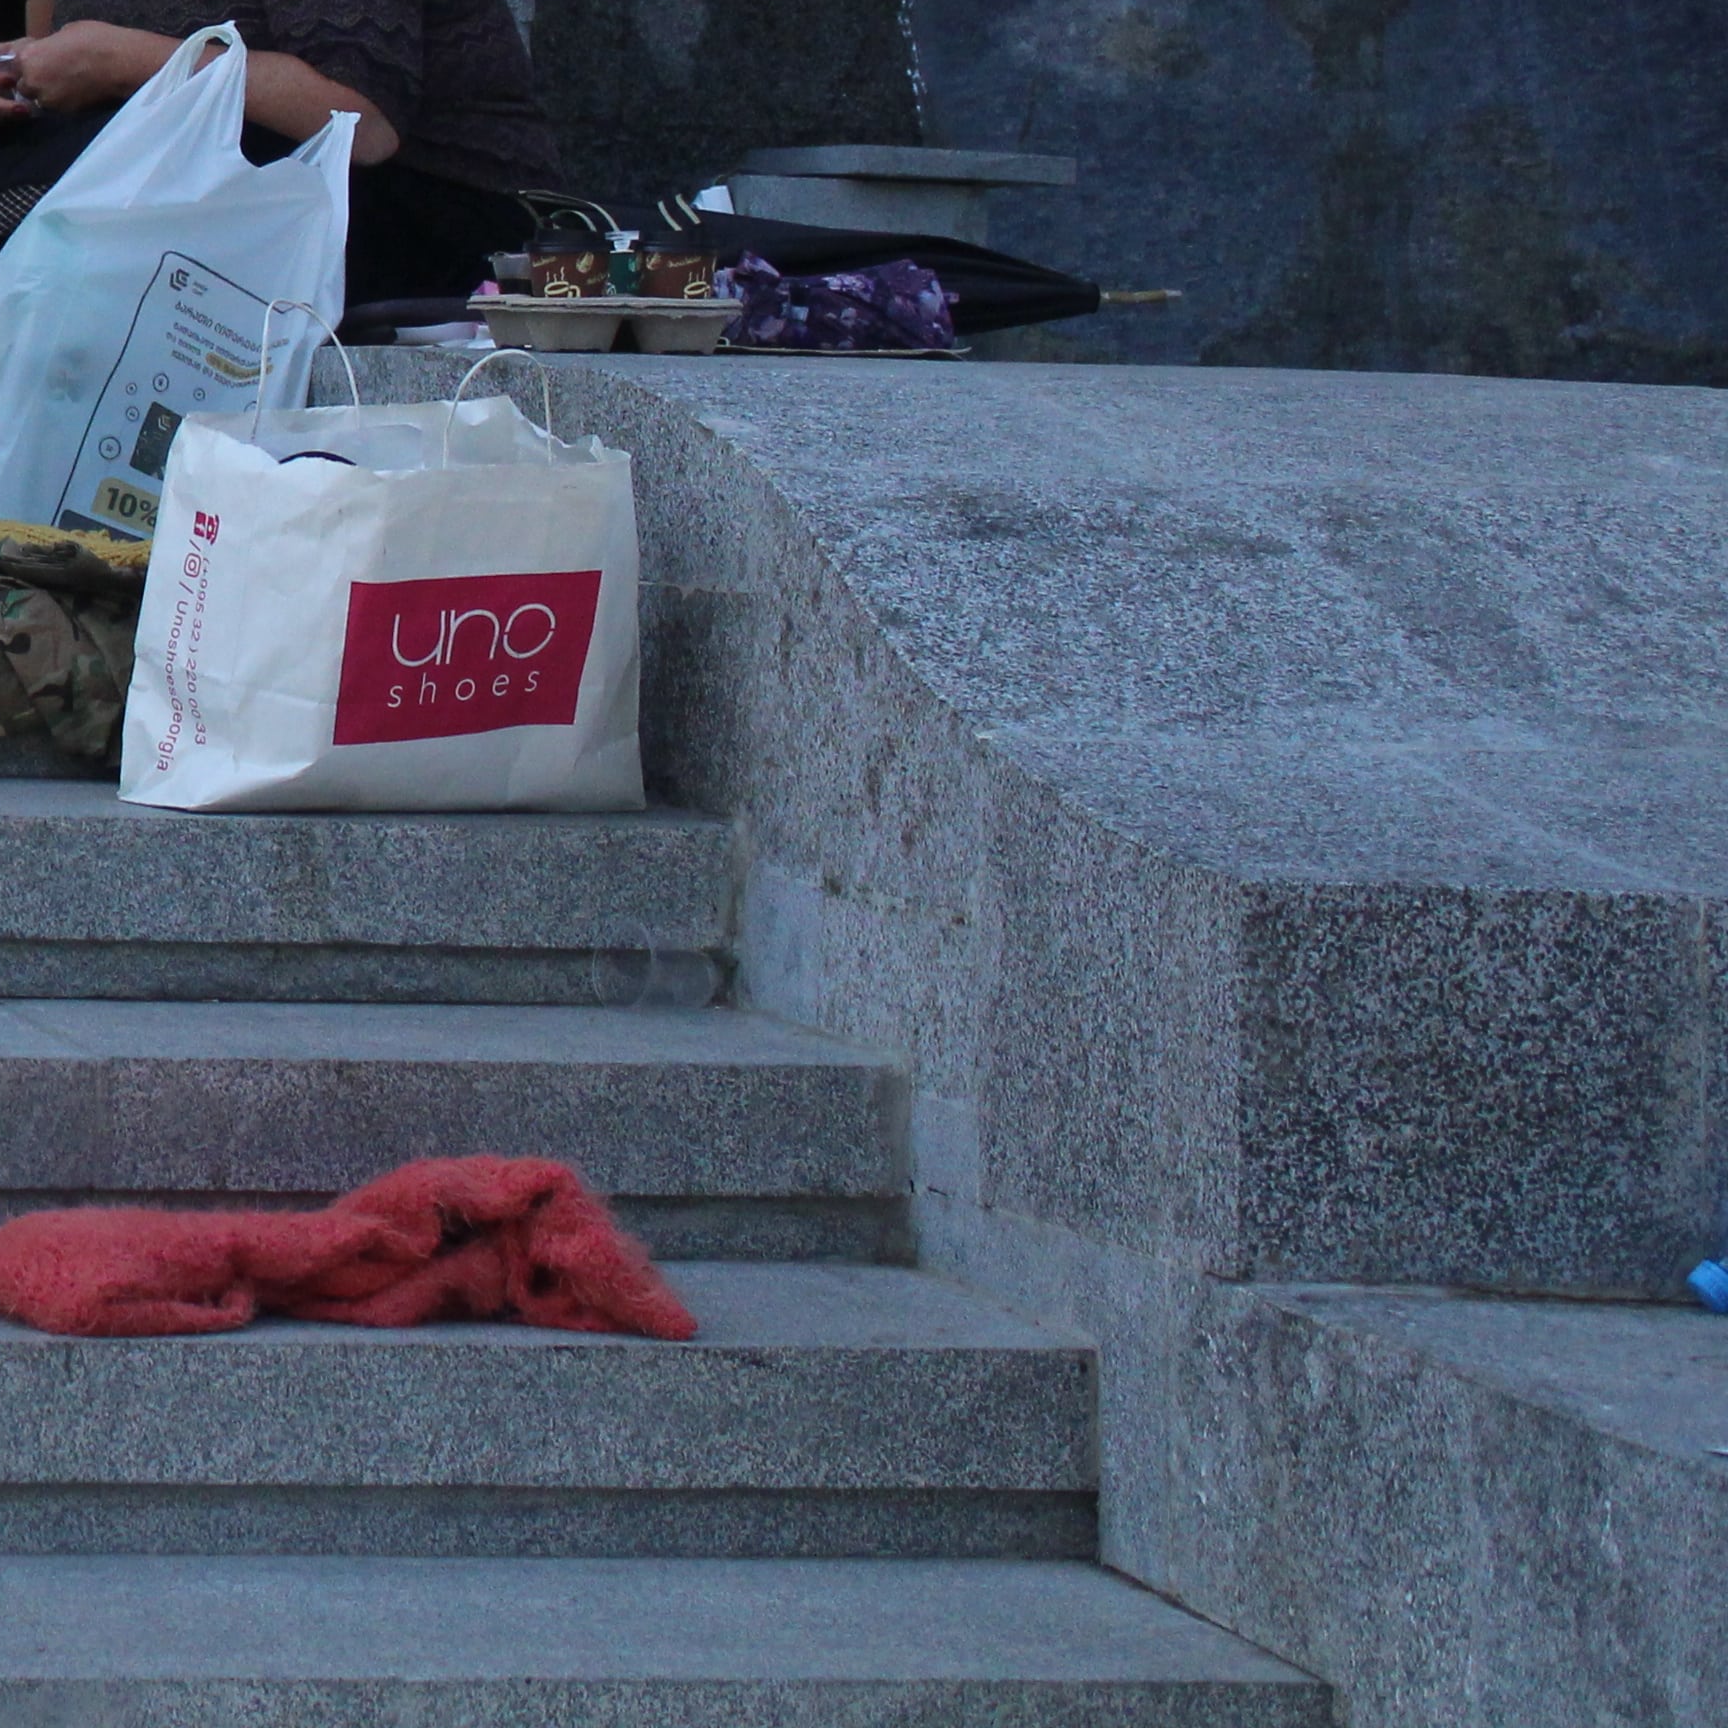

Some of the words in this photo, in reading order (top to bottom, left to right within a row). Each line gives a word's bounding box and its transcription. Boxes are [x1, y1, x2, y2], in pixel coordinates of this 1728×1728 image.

[393, 604, 555, 666] uno
[156, 600, 189, 772] UnoshoesGeorgia
[388, 671, 539, 707] shoes
[193, 722, 208, 745] 33
